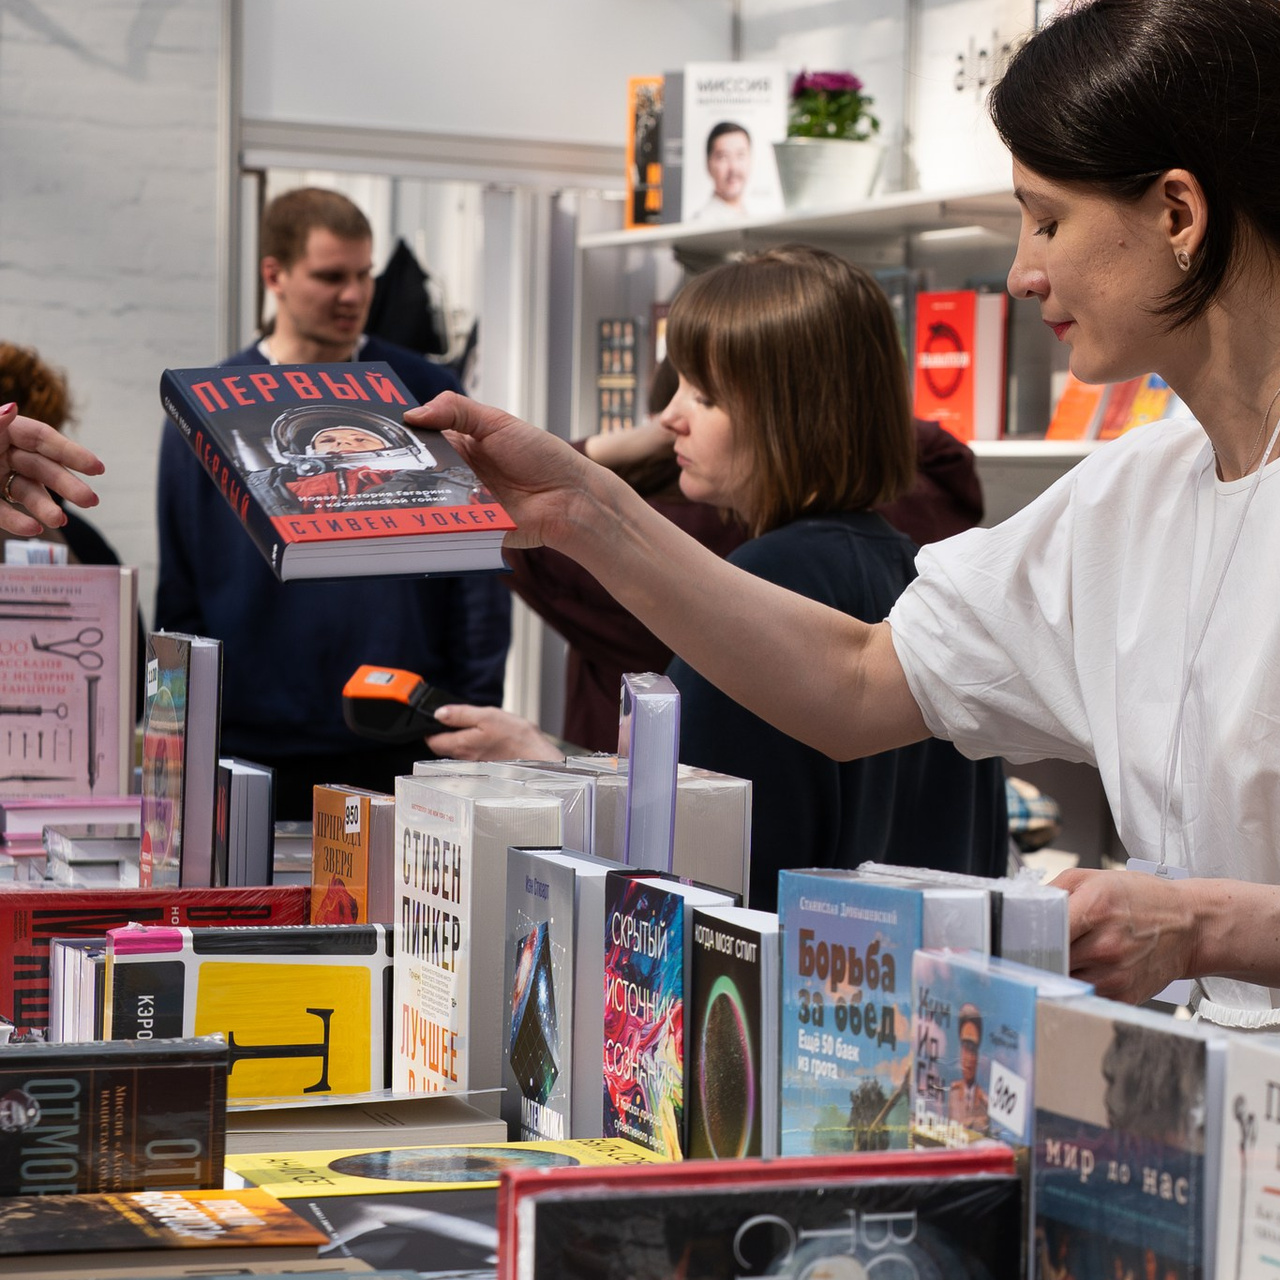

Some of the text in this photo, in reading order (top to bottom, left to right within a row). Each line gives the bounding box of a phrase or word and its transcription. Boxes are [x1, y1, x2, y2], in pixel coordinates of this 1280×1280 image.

[191, 371, 408, 413] ПЕРВЫЙ
[195, 431, 249, 523] ПЕРВЫЙ
[298, 488, 453, 504] Новая история Гагарина
[292, 509, 499, 535] СТИВЕН УОКЕР
[325, 497, 408, 509] космической
[411, 494, 448, 506] гонки
[0, 658, 63, 669] АССКАЗОВ
[346, 804, 359, 826] 950
[323, 845, 353, 879] ЗВЕРЯ
[403, 826, 461, 904] СТИВЕН
[800, 896, 898, 926] Станислав Дробышевский
[402, 895, 460, 973] ПИНКЕР
[612, 910, 668, 962] СКРЫТЫЙ
[694, 923, 758, 963] КОГДА МОЗГ СПИТ
[798, 928, 896, 995] Борьба
[137, 994, 155, 1040] КЭРО
[605, 974, 675, 1033] ИСТОЧНИК
[798, 988, 897, 1052] за обед
[918, 985, 951, 1026] Ким
[400, 1003, 459, 1083] ЛУЧШЕЕ
[798, 1028, 860, 1062] Ещё 50 баек
[605, 1037, 675, 1096] СОЗНАНИЯ
[797, 1055, 838, 1080] из грота
[20, 1078, 82, 1194] ОТМО
[521, 1096, 564, 1141] МАТЕМАТИКА
[112, 1140, 125, 1191] «Алсос
